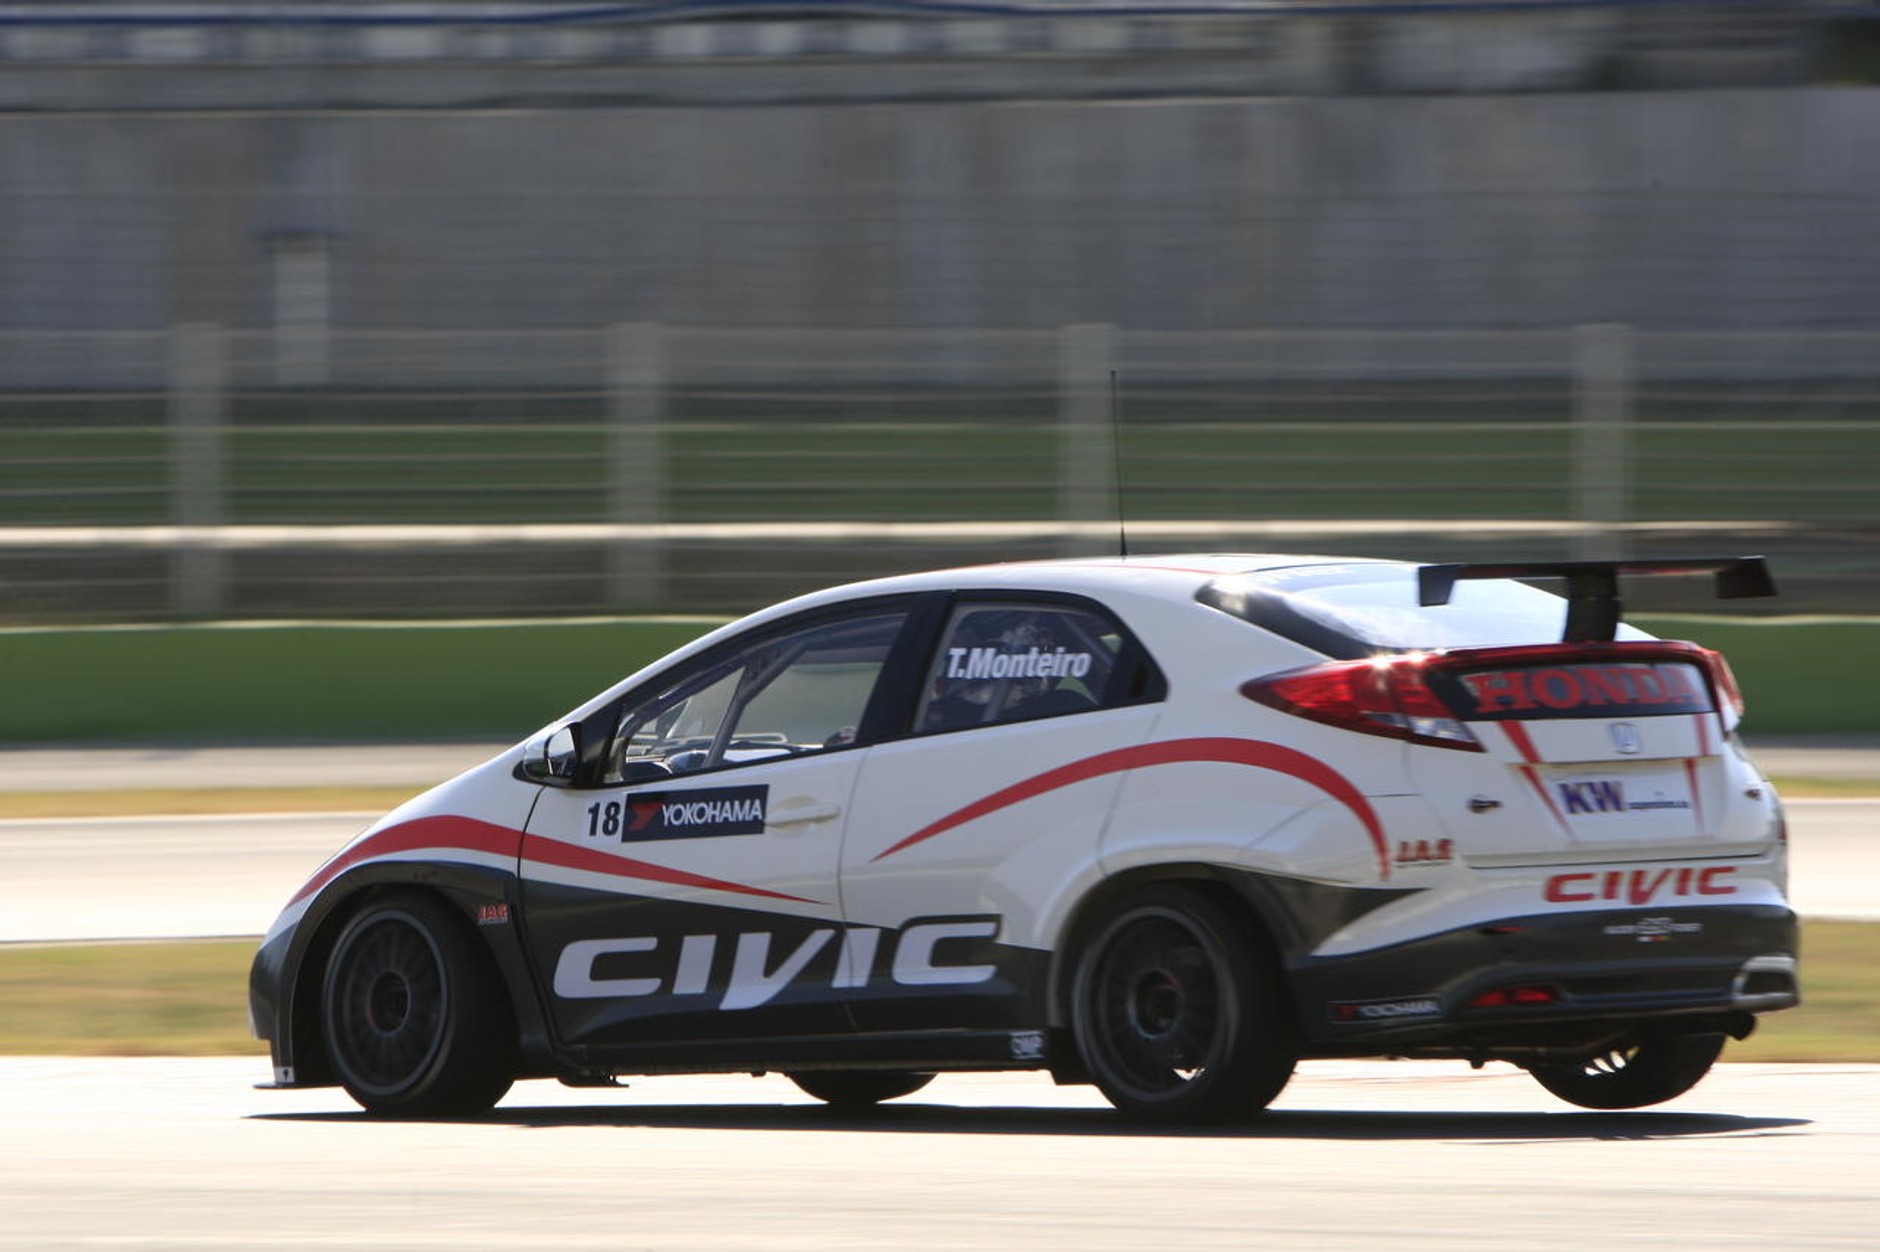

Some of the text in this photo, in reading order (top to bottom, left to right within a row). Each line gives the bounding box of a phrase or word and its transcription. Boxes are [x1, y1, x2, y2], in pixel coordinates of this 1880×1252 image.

[947, 646, 1092, 680] T.Monteiro
[1466, 667, 1700, 712] HONDA
[662, 799, 763, 827] YOKOHAMA
[1557, 780, 1626, 815] KW
[587, 800, 622, 837] 18
[1543, 866, 1738, 906] CIVIC
[553, 922, 998, 1011] CIVIC
